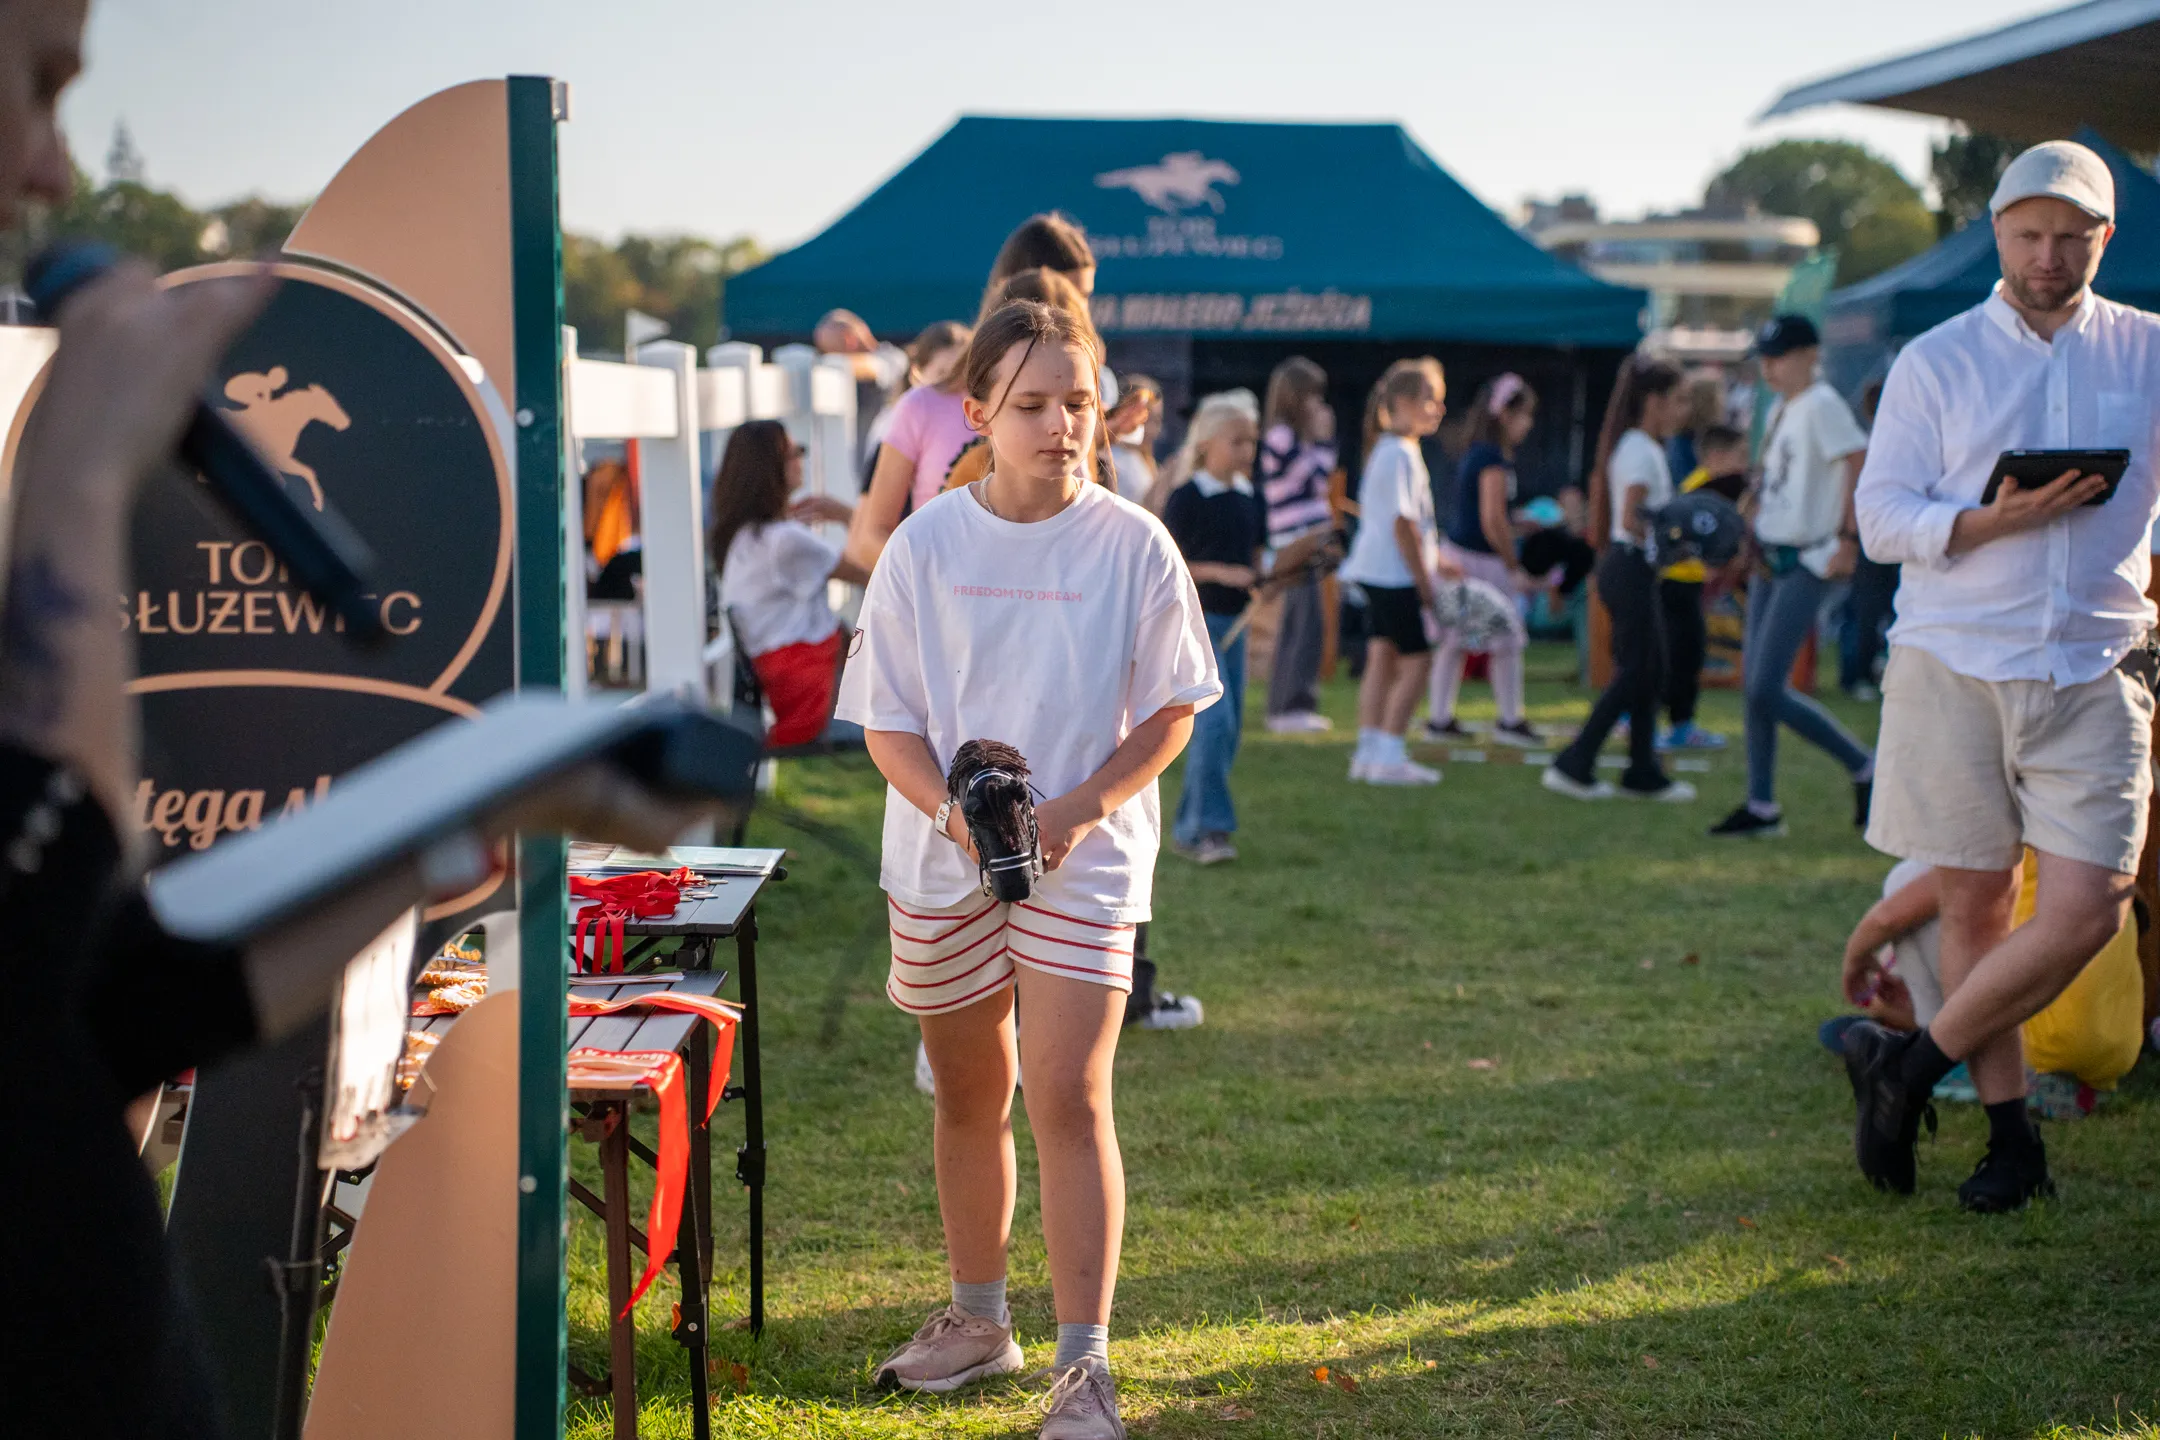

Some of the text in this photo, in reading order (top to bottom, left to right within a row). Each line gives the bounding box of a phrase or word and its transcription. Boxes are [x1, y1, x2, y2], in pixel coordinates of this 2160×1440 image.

[196, 541, 290, 586] TO
[953, 585, 1083, 602] FREEDOM TO DREAM
